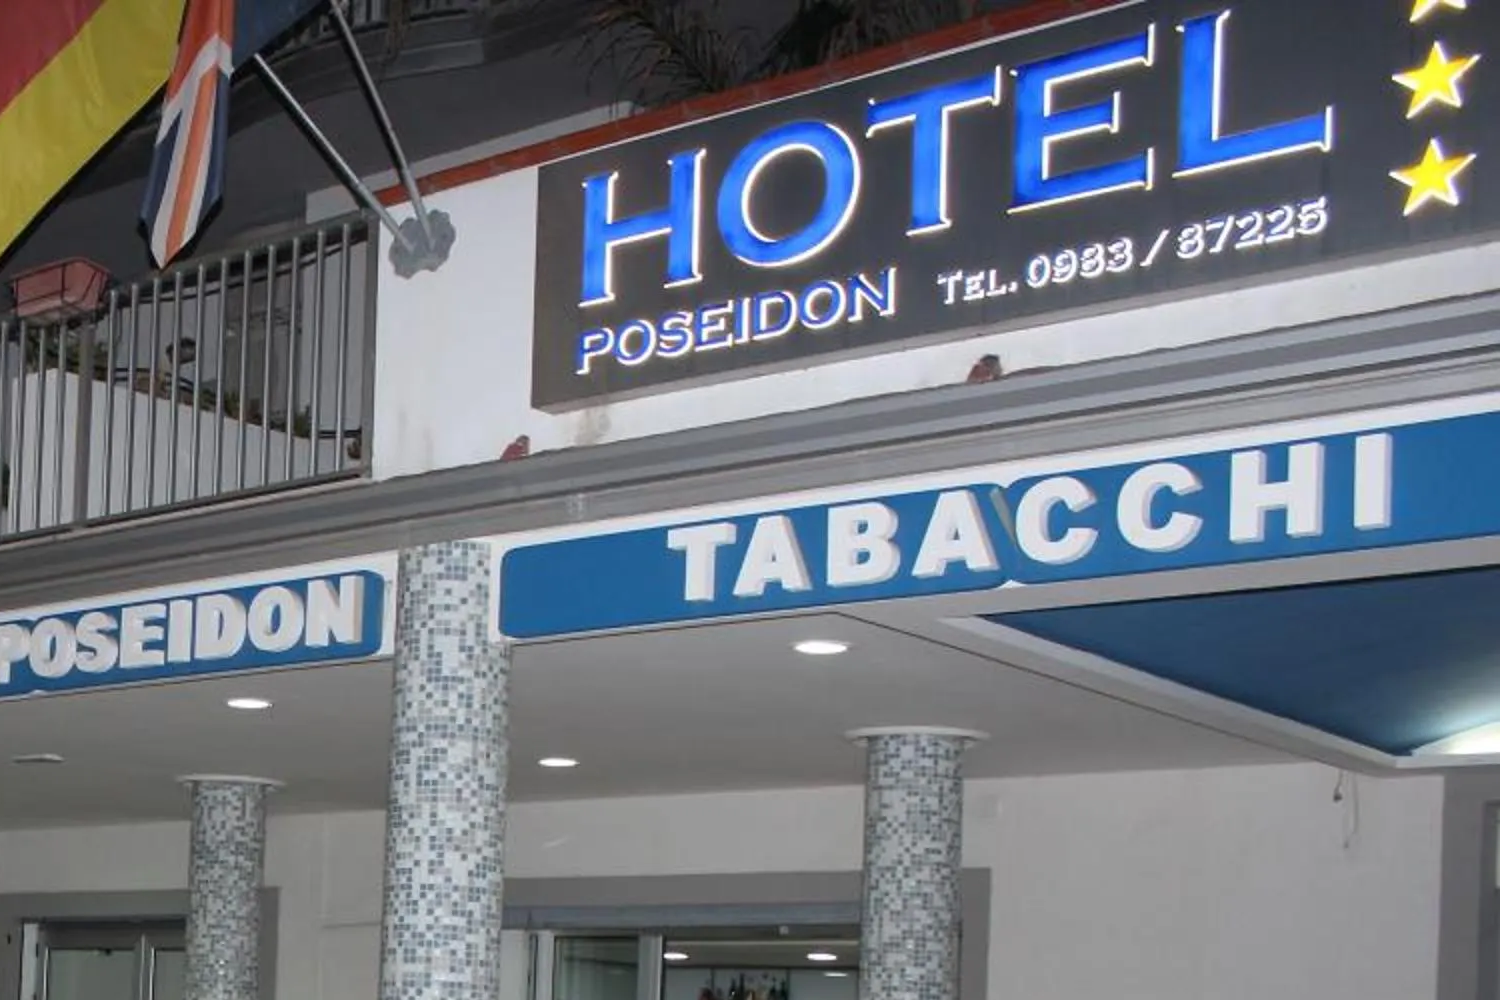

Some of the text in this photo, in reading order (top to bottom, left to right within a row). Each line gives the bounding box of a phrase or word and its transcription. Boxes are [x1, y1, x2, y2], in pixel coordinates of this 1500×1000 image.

[580, 9, 1333, 307] HOTEL
[575, 267, 897, 375] POSEIDON
[667, 433, 1393, 603] TABACCHI
